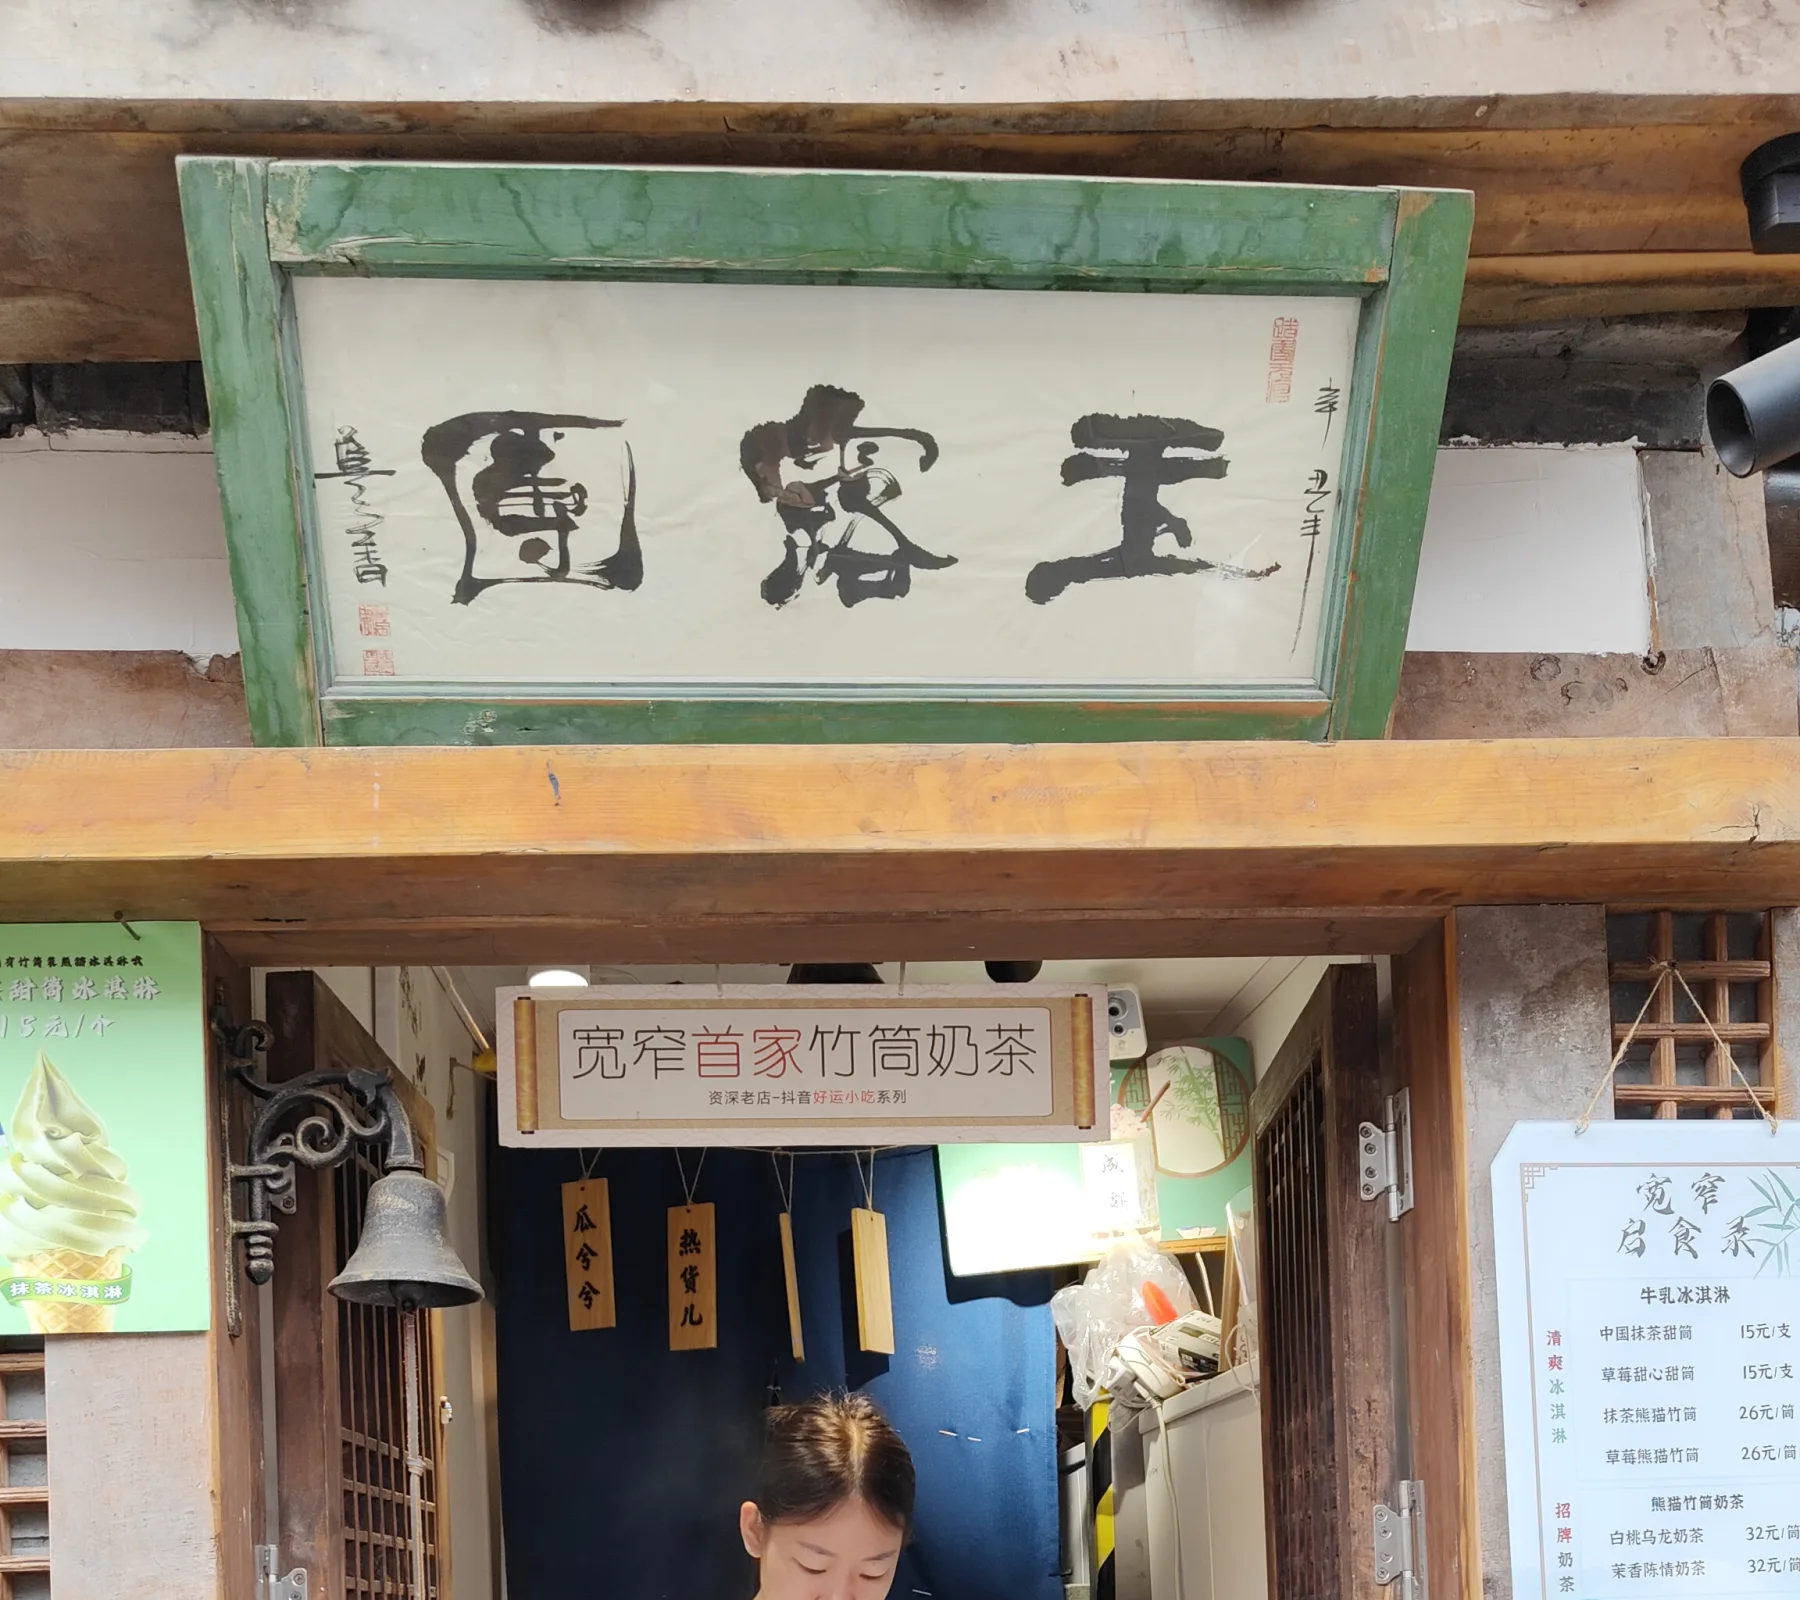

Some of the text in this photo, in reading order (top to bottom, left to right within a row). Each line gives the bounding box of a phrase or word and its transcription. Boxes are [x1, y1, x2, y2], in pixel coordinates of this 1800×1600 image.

[0, 975, 163, 1002] 甜筒冰淇淋
[572, 1022, 1038, 1080] 宽窄首家竹筒奶茶
[573, 1204, 598, 1311] 瓜兮兮
[678, 1227, 704, 1328] 热货儿
[9, 1281, 124, 1299] 抹茶冰淇淋
[1640, 1285, 1731, 1305] 牛乳冰淇淋
[1599, 1323, 1792, 1342] 中国抹茶甜筒 15元/支
[1601, 1363, 1794, 1383] 草莓甜心甜筒 15元/支
[1546, 1330, 1567, 1444] 清爽冰淇淋
[1603, 1404, 1795, 1424] 抹茶熊猫竹筒 26元/筒
[1605, 1444, 1797, 1465] 草莓熊猫竹筒 26元/筒
[1651, 1494, 1744, 1512] 熊猫竹筒奶茶
[1609, 1524, 1800, 1546] 白桃乌龙奶茶 32元/筒
[1555, 1502, 1575, 1593] 招牌奶茶
[1611, 1560, 1706, 1579] 茉香陈情奶茶
